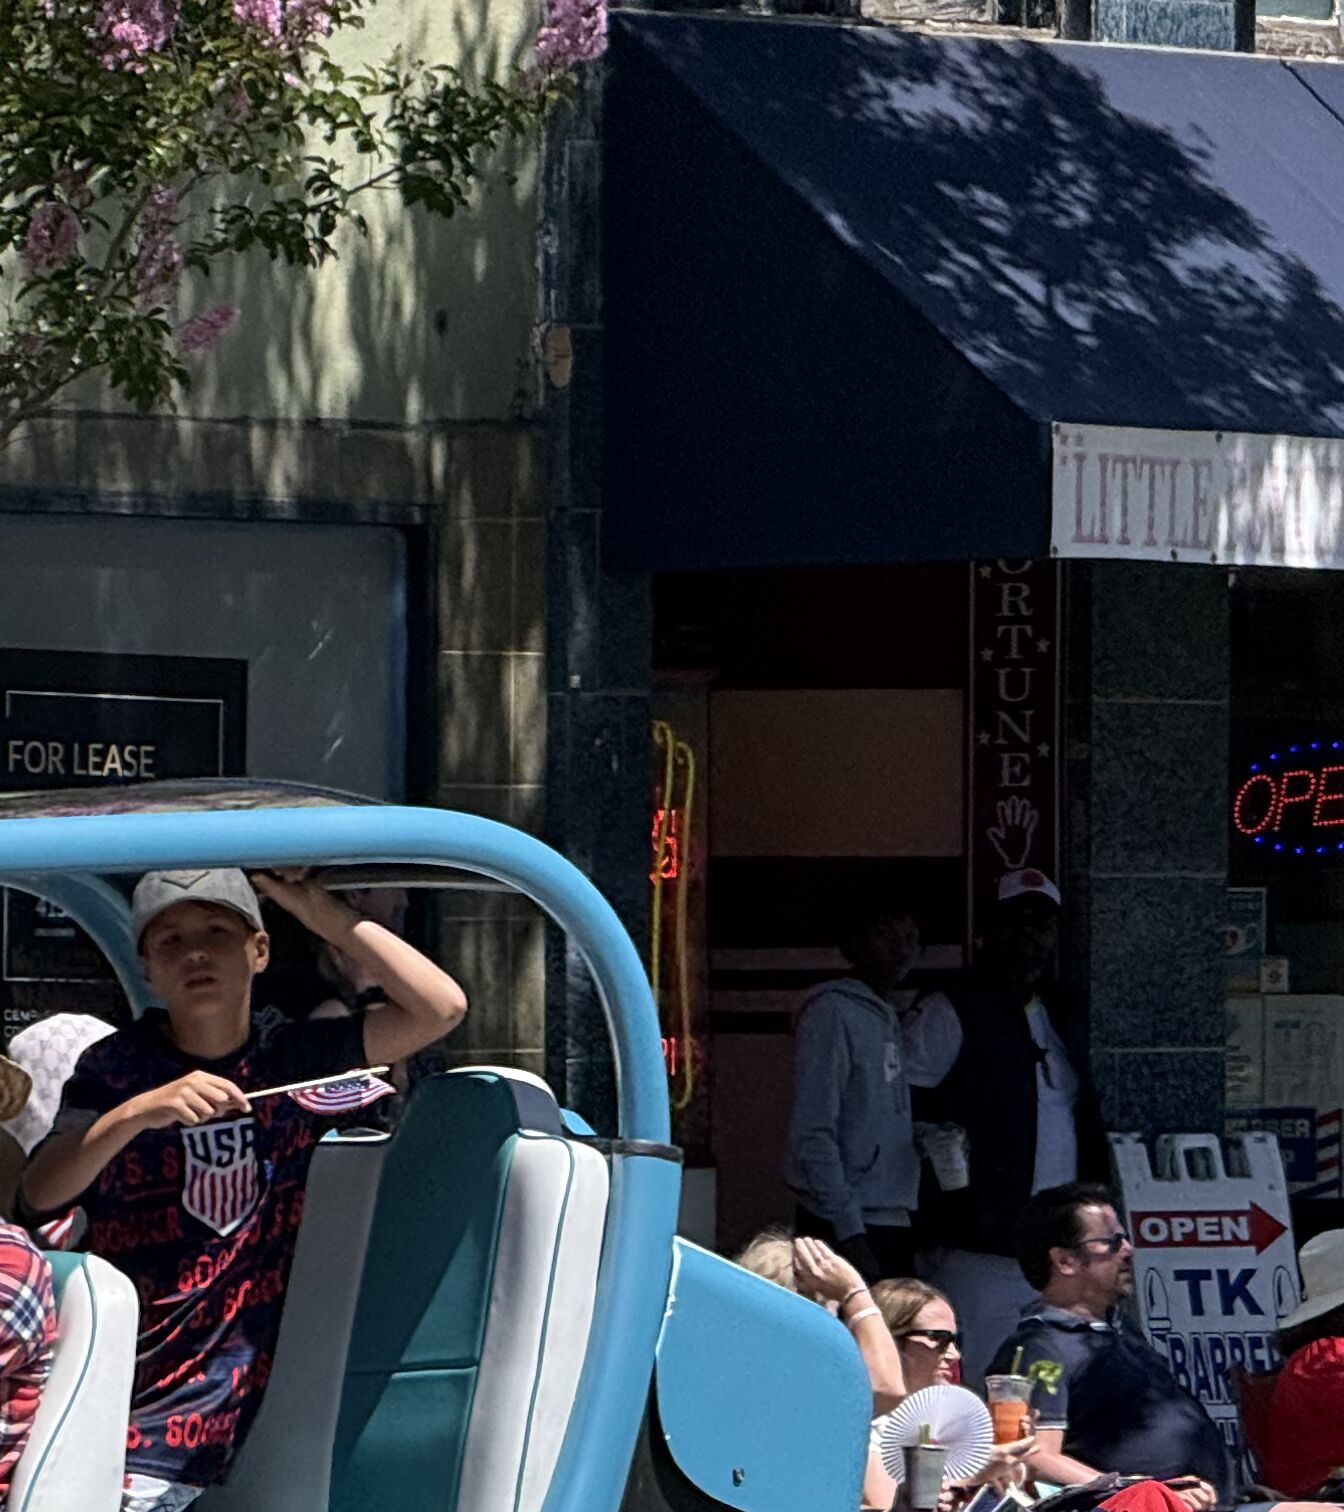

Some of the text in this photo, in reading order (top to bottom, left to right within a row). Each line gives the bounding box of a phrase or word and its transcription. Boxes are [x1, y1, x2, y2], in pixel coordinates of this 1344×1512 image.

[1072, 452, 1214, 549] LITTLE
[7, 740, 157, 779] FOR LEASE
[1138, 1215, 1251, 1243] OPEN
[1174, 1268, 1265, 1317] TK
